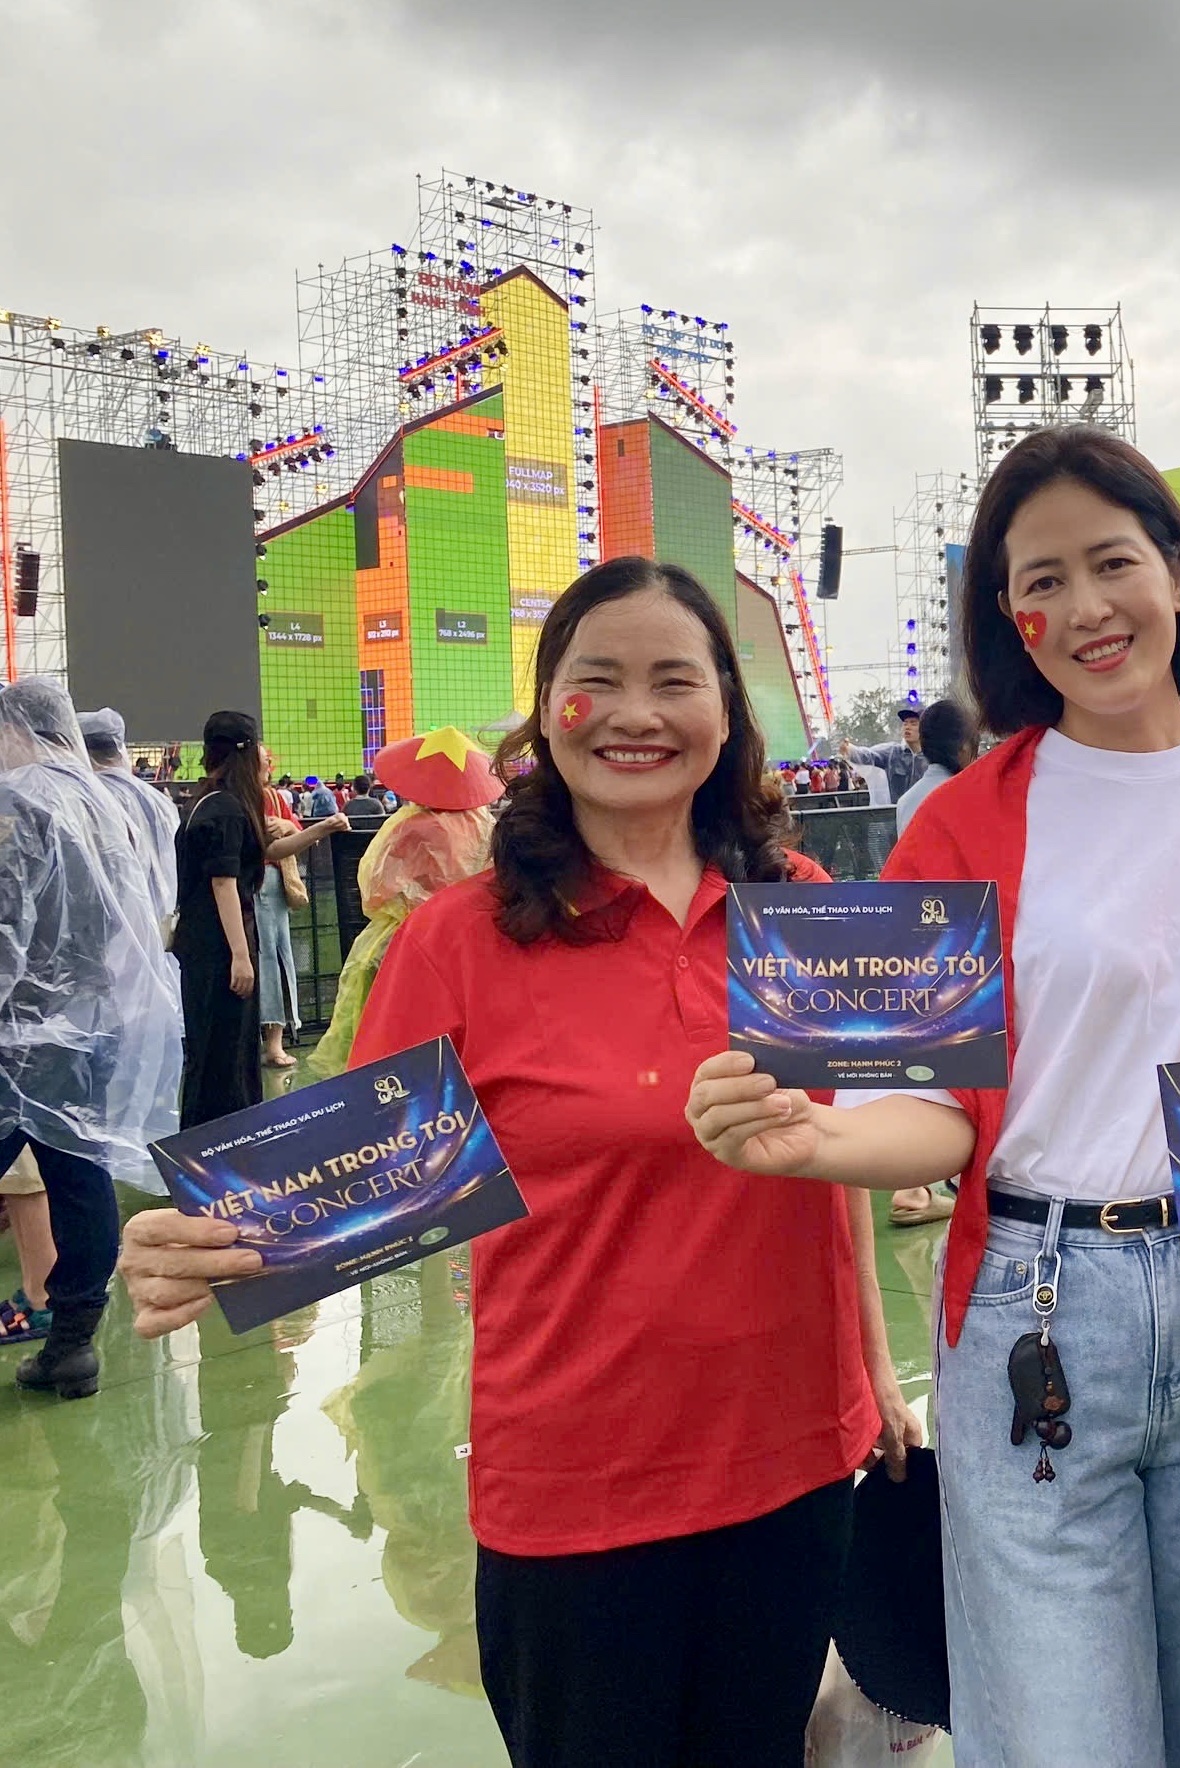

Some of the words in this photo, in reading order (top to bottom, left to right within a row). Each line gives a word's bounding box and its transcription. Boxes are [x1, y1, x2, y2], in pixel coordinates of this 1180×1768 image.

[508, 466, 553, 480] FULLMAP
[763, 906, 774, 915] BỘ
[775, 906, 790, 914] VĂN
[792, 905, 810, 915] HÓA,
[849, 905, 861, 913] VÀ
[875, 906, 893, 915] LỊCH
[742, 952, 790, 983] VIỆT
[795, 957, 849, 978] NAM
[854, 956, 939, 977] TRONG
[943, 949, 986, 977] TÔI
[786, 987, 939, 1018] CONCERT
[200, 1147, 215, 1158] BỘ
[273, 1118, 297, 1132] THAO
[311, 1108, 324, 1118] DU
[325, 1100, 346, 1113] LỊCH
[199, 1189, 255, 1220] VIỆT
[260, 1165, 324, 1203] NAM
[324, 1130, 418, 1179] TRONG
[418, 1110, 469, 1142] TÔI
[265, 1158, 424, 1236] CONCERT
